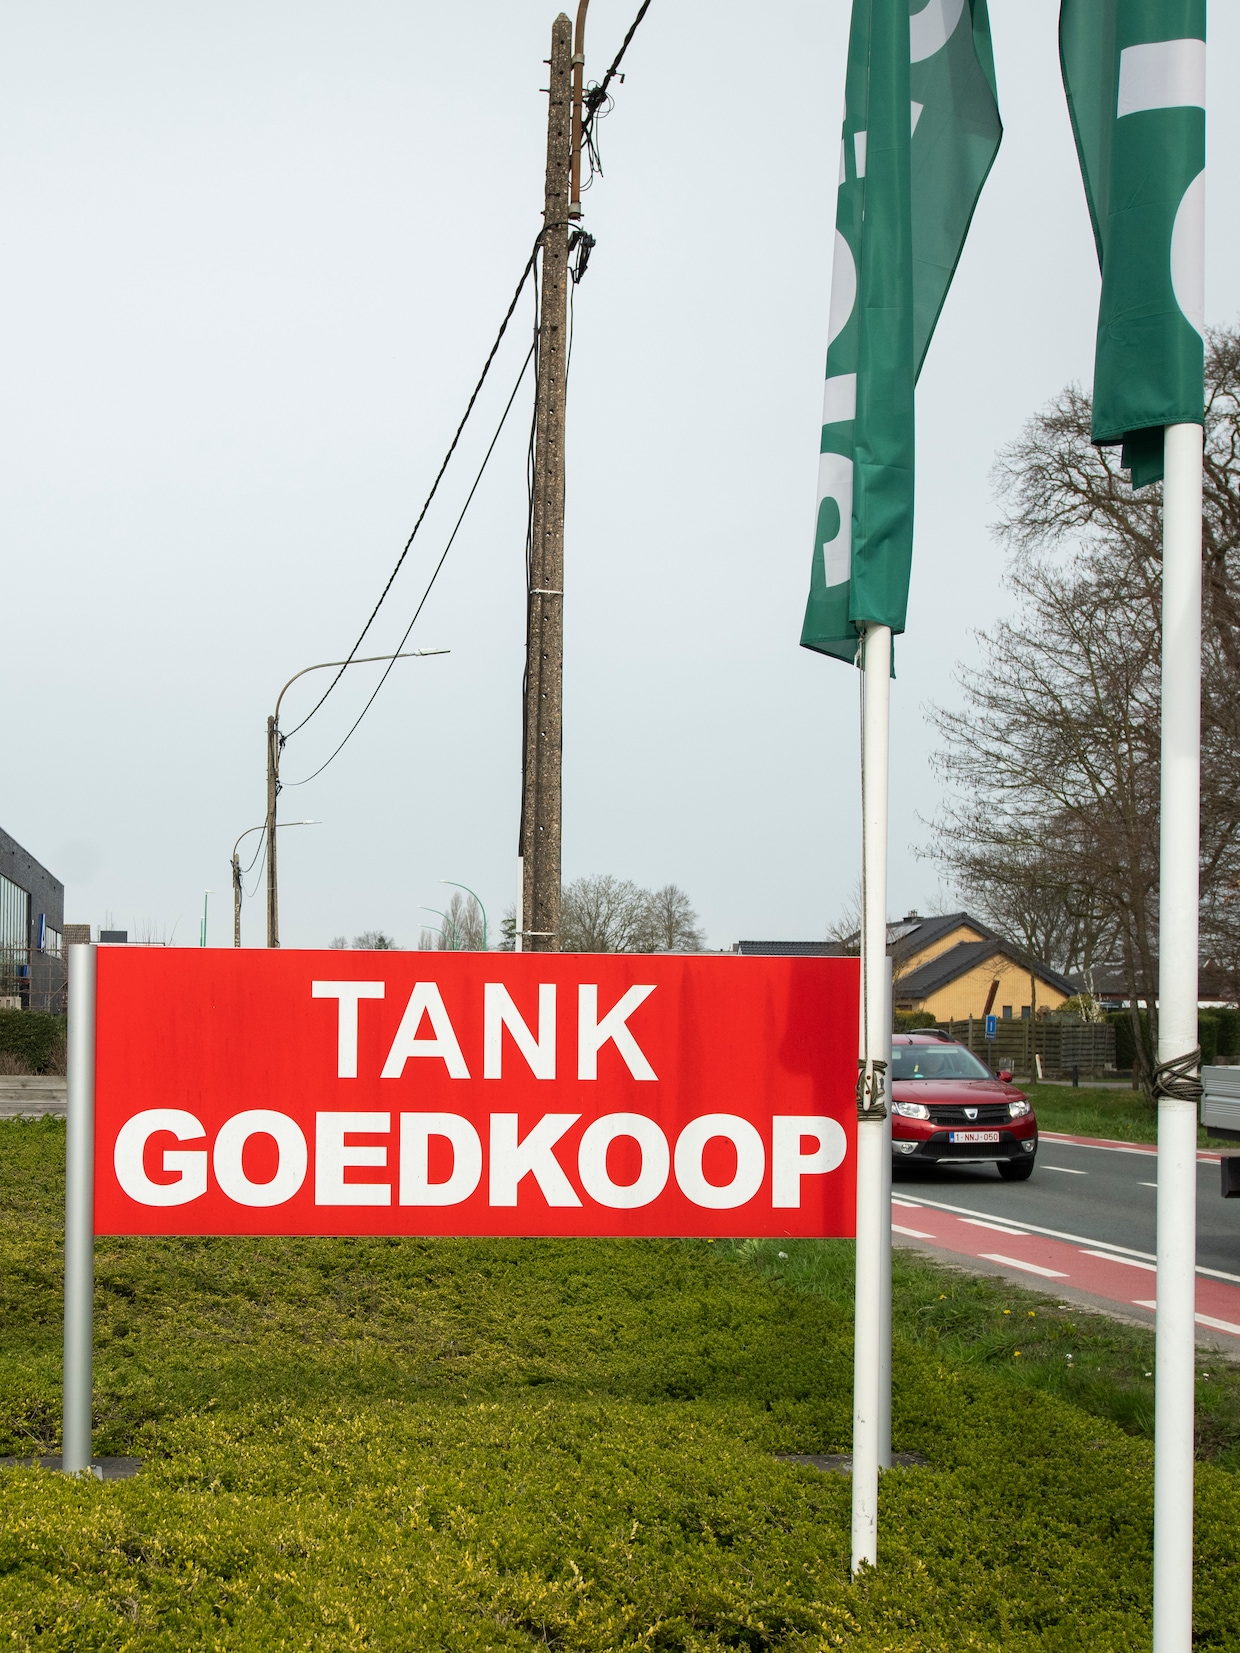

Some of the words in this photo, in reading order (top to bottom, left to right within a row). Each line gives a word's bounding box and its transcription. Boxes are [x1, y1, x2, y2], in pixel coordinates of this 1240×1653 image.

[311, 980, 659, 1081] TANK
[113, 1108, 847, 1210] GOEDKOOP
[955, 1133, 999, 1141] 1-NNJ-050
